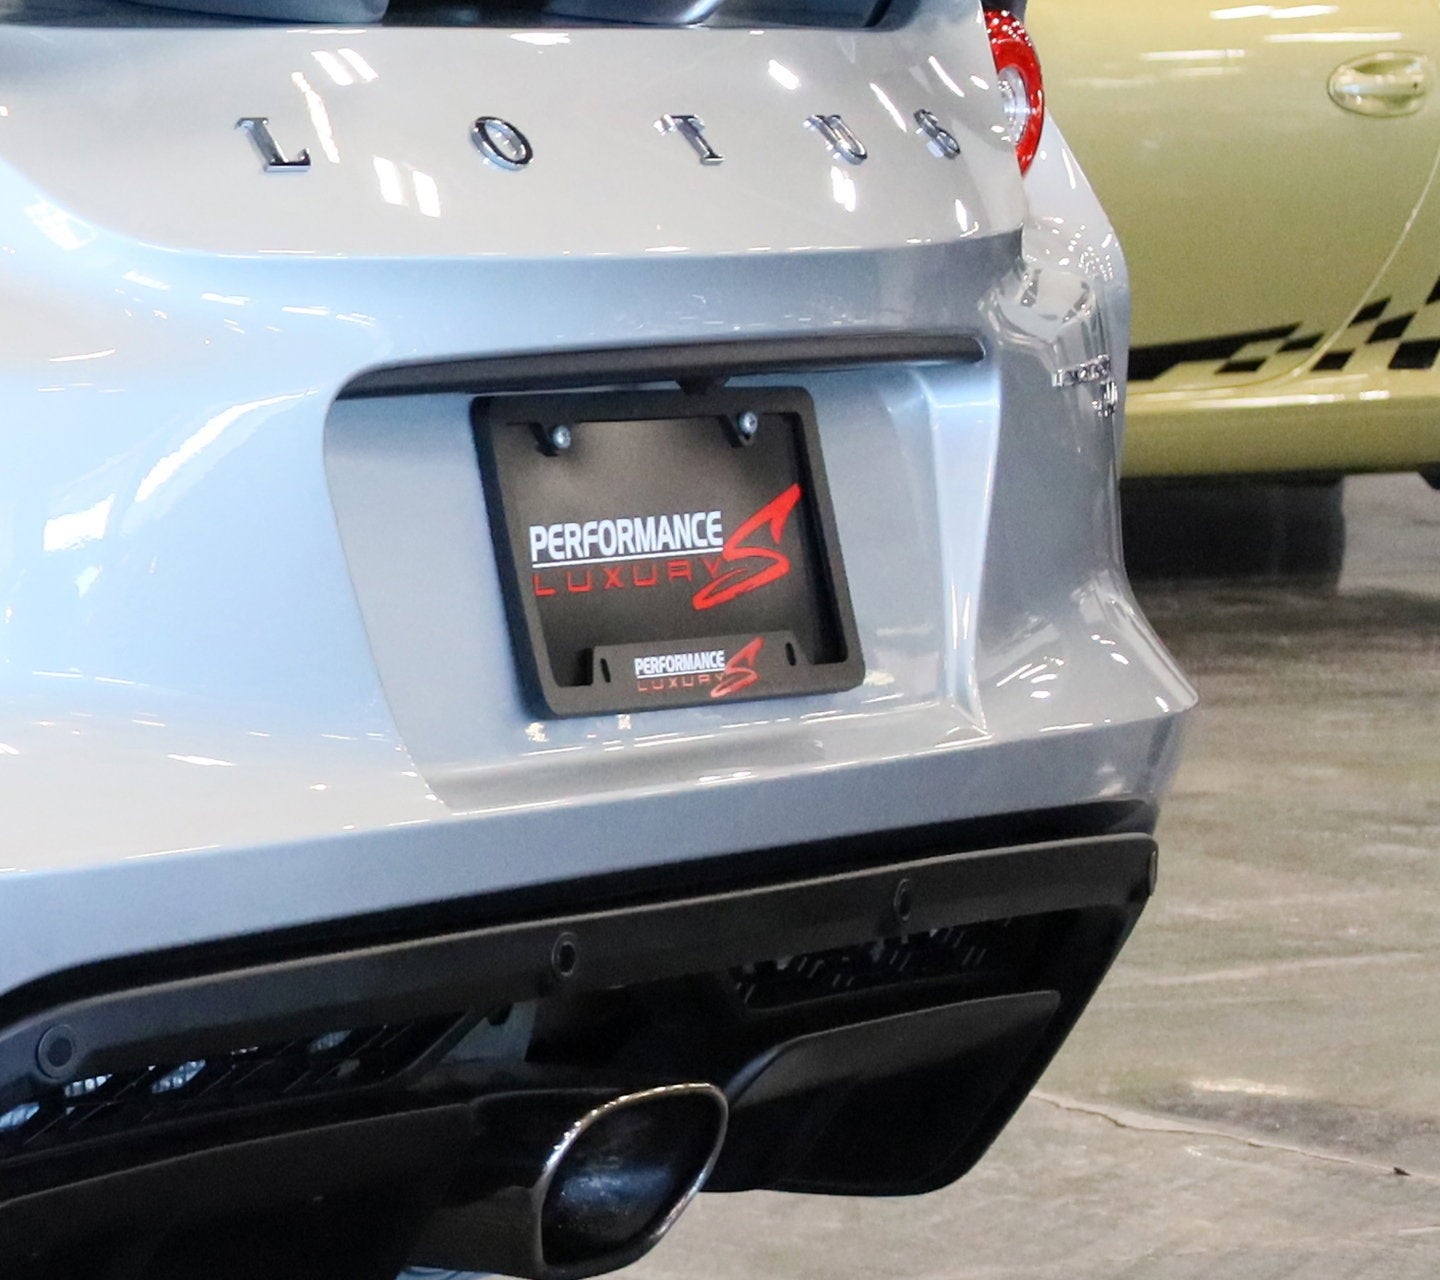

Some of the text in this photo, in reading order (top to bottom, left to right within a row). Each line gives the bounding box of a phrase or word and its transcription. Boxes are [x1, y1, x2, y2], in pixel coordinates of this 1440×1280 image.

[234, 107, 961, 173] LOTUS
[529, 509, 724, 563] PERFORMANCE
[532, 558, 724, 597] LUXURY
[634, 649, 726, 676] PERFORMANCE
[636, 671, 726, 692] LUXURY
